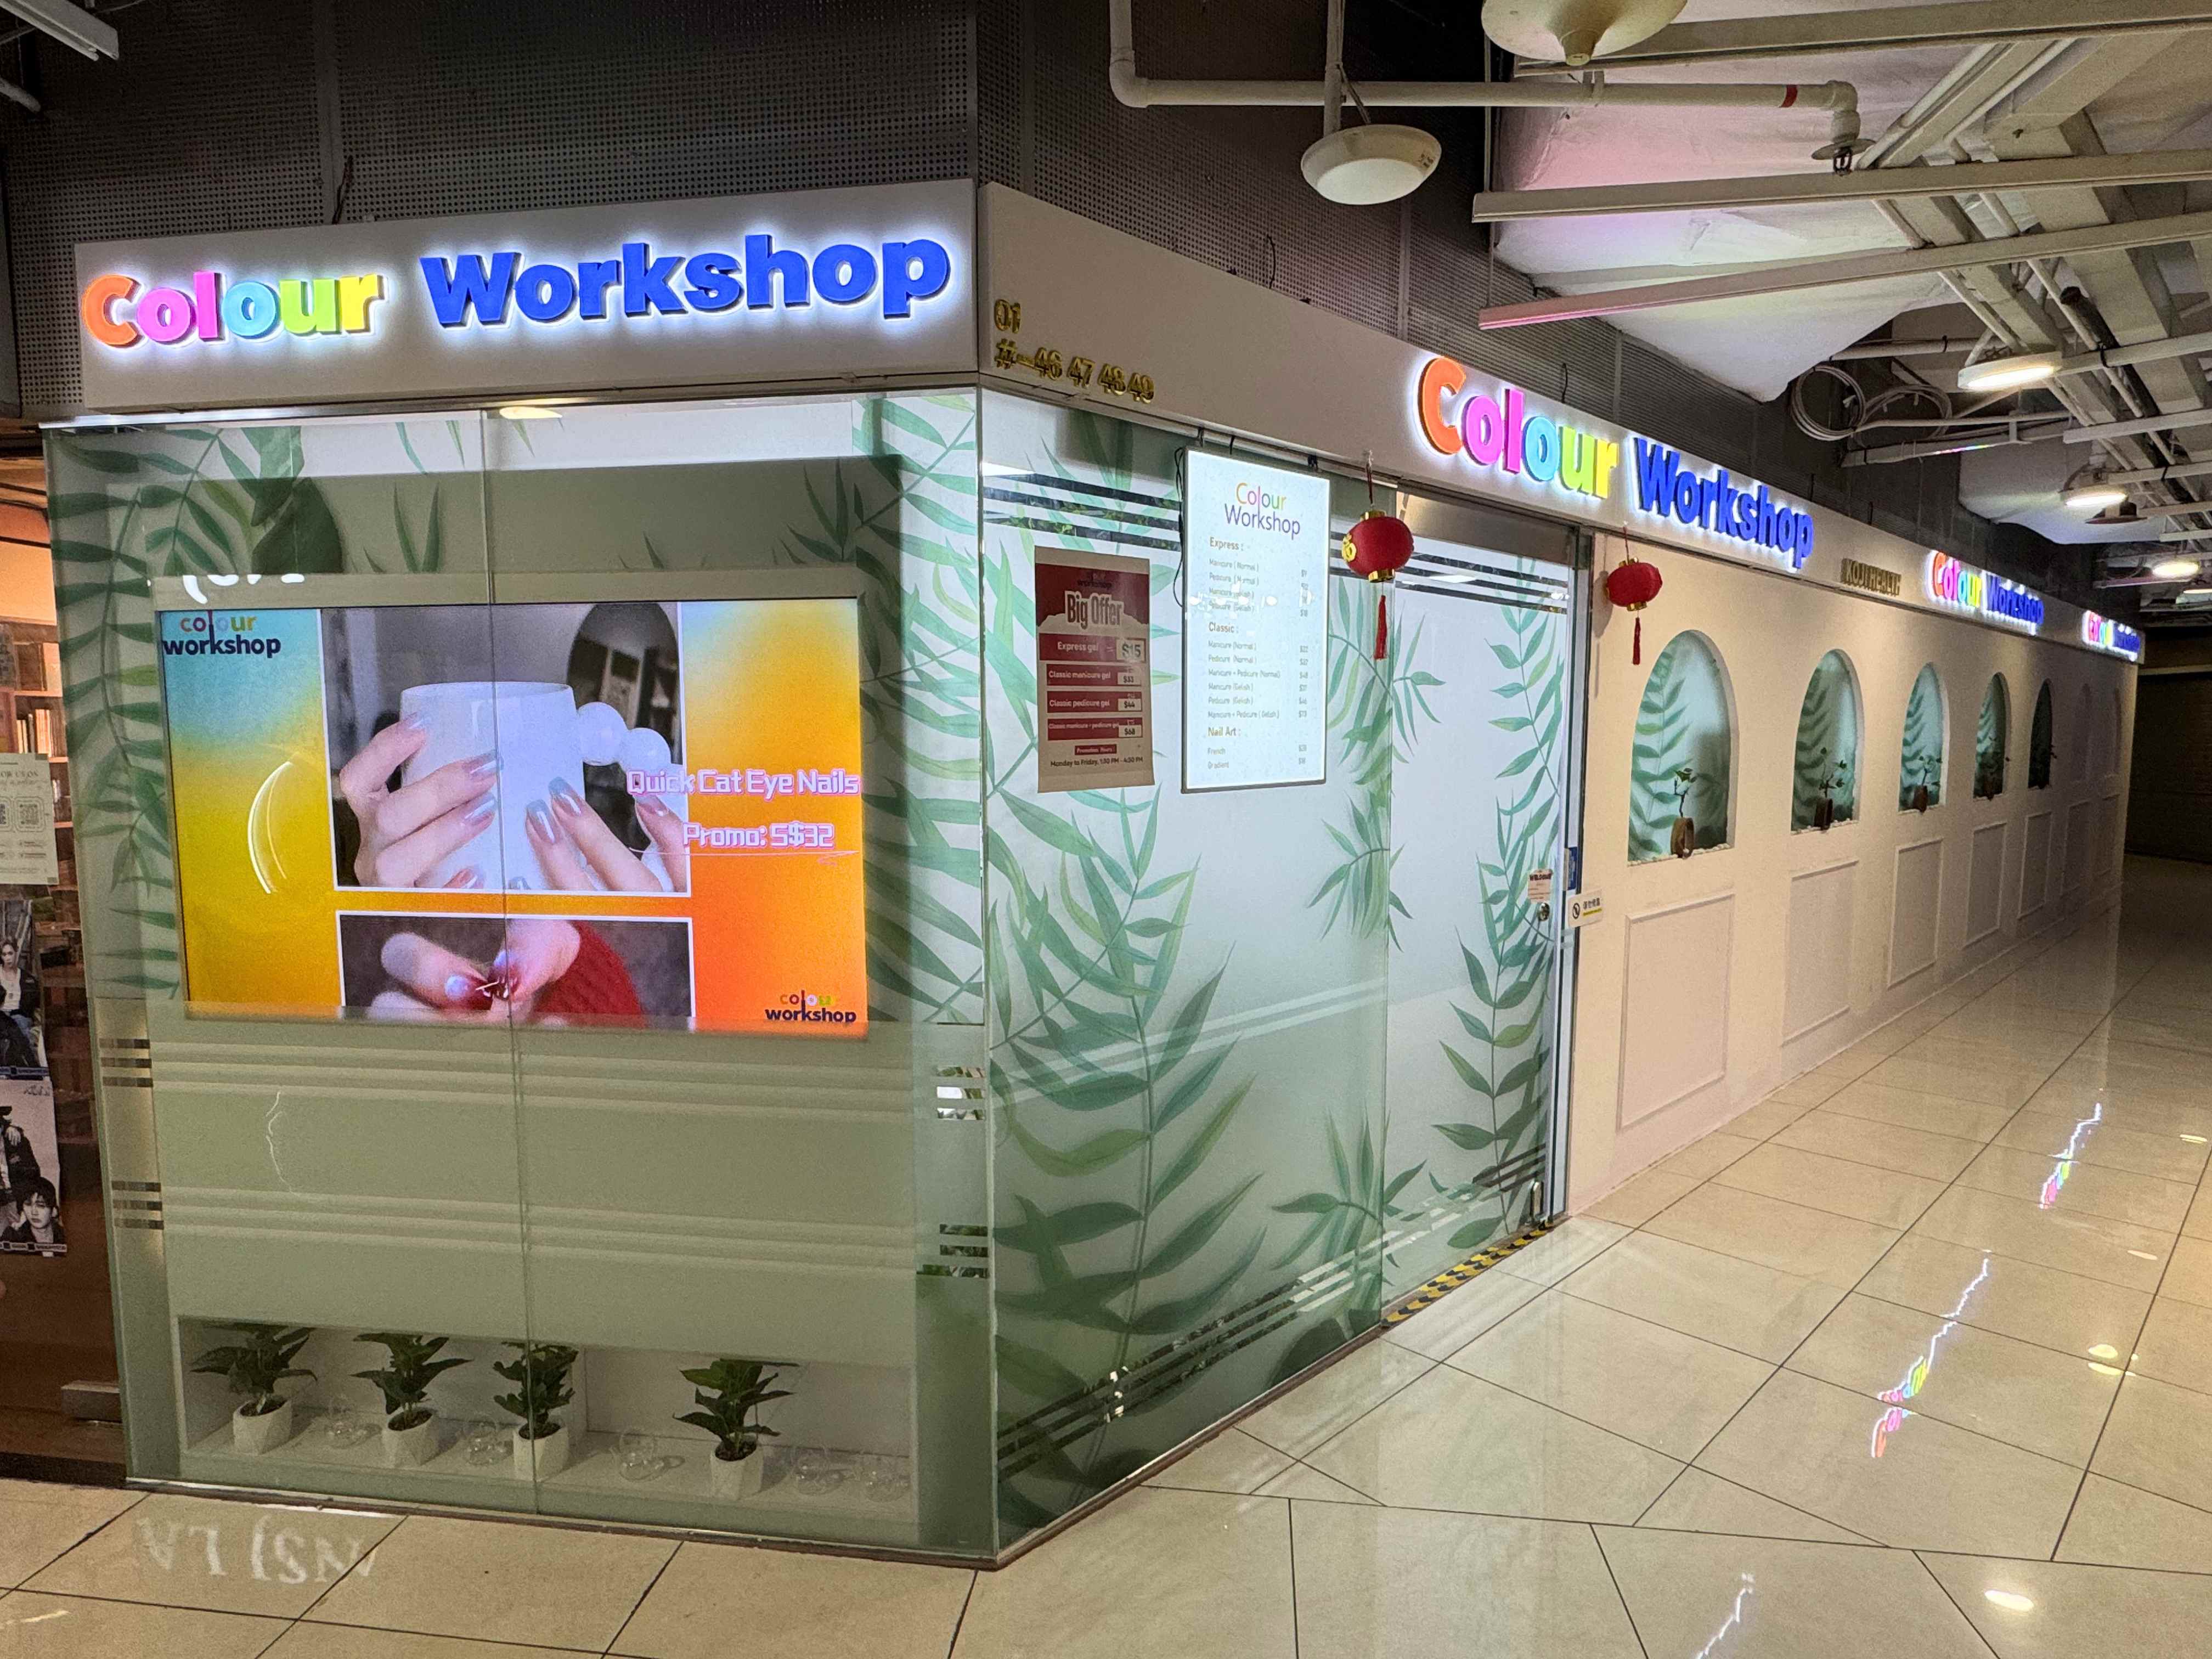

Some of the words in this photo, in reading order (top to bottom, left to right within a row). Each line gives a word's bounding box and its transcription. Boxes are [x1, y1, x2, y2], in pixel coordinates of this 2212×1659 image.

[81, 270, 382, 347] Colour
[420, 234, 950, 328] Workshop
[994, 299, 1021, 334] 01
[1067, 357, 1096, 388] 47
[1098, 363, 1126, 396] 48
[1127, 373, 1154, 403] 49
[1418, 356, 1619, 499] Colour
[1634, 437, 1814, 568] Workshop
[1236, 482, 1286, 510] Colour
[1224, 503, 1300, 540] Workshop
[1933, 550, 1982, 608] Colour
[180, 610, 258, 633] colour
[1066, 594, 1088, 630] Big
[1091, 595, 1122, 626] Offer
[1209, 622, 1234, 633] Classic
[164, 634, 281, 658] workshop
[1057, 641, 1086, 652] Express
[1122, 642, 1141, 658] $15
[1048, 670, 1071, 679] Classic
[1049, 699, 1072, 707] Classic
[1073, 698, 1099, 708] pedicure
[1208, 727, 1223, 737] Nail
[1225, 726, 1237, 736] Art
[626, 769, 695, 795] Quick
[697, 769, 742, 795] Cat
[745, 768, 794, 802] Eye
[796, 768, 862, 795] Nails
[682, 822, 768, 848] Promo:
[765, 1007, 856, 1023] workshop
